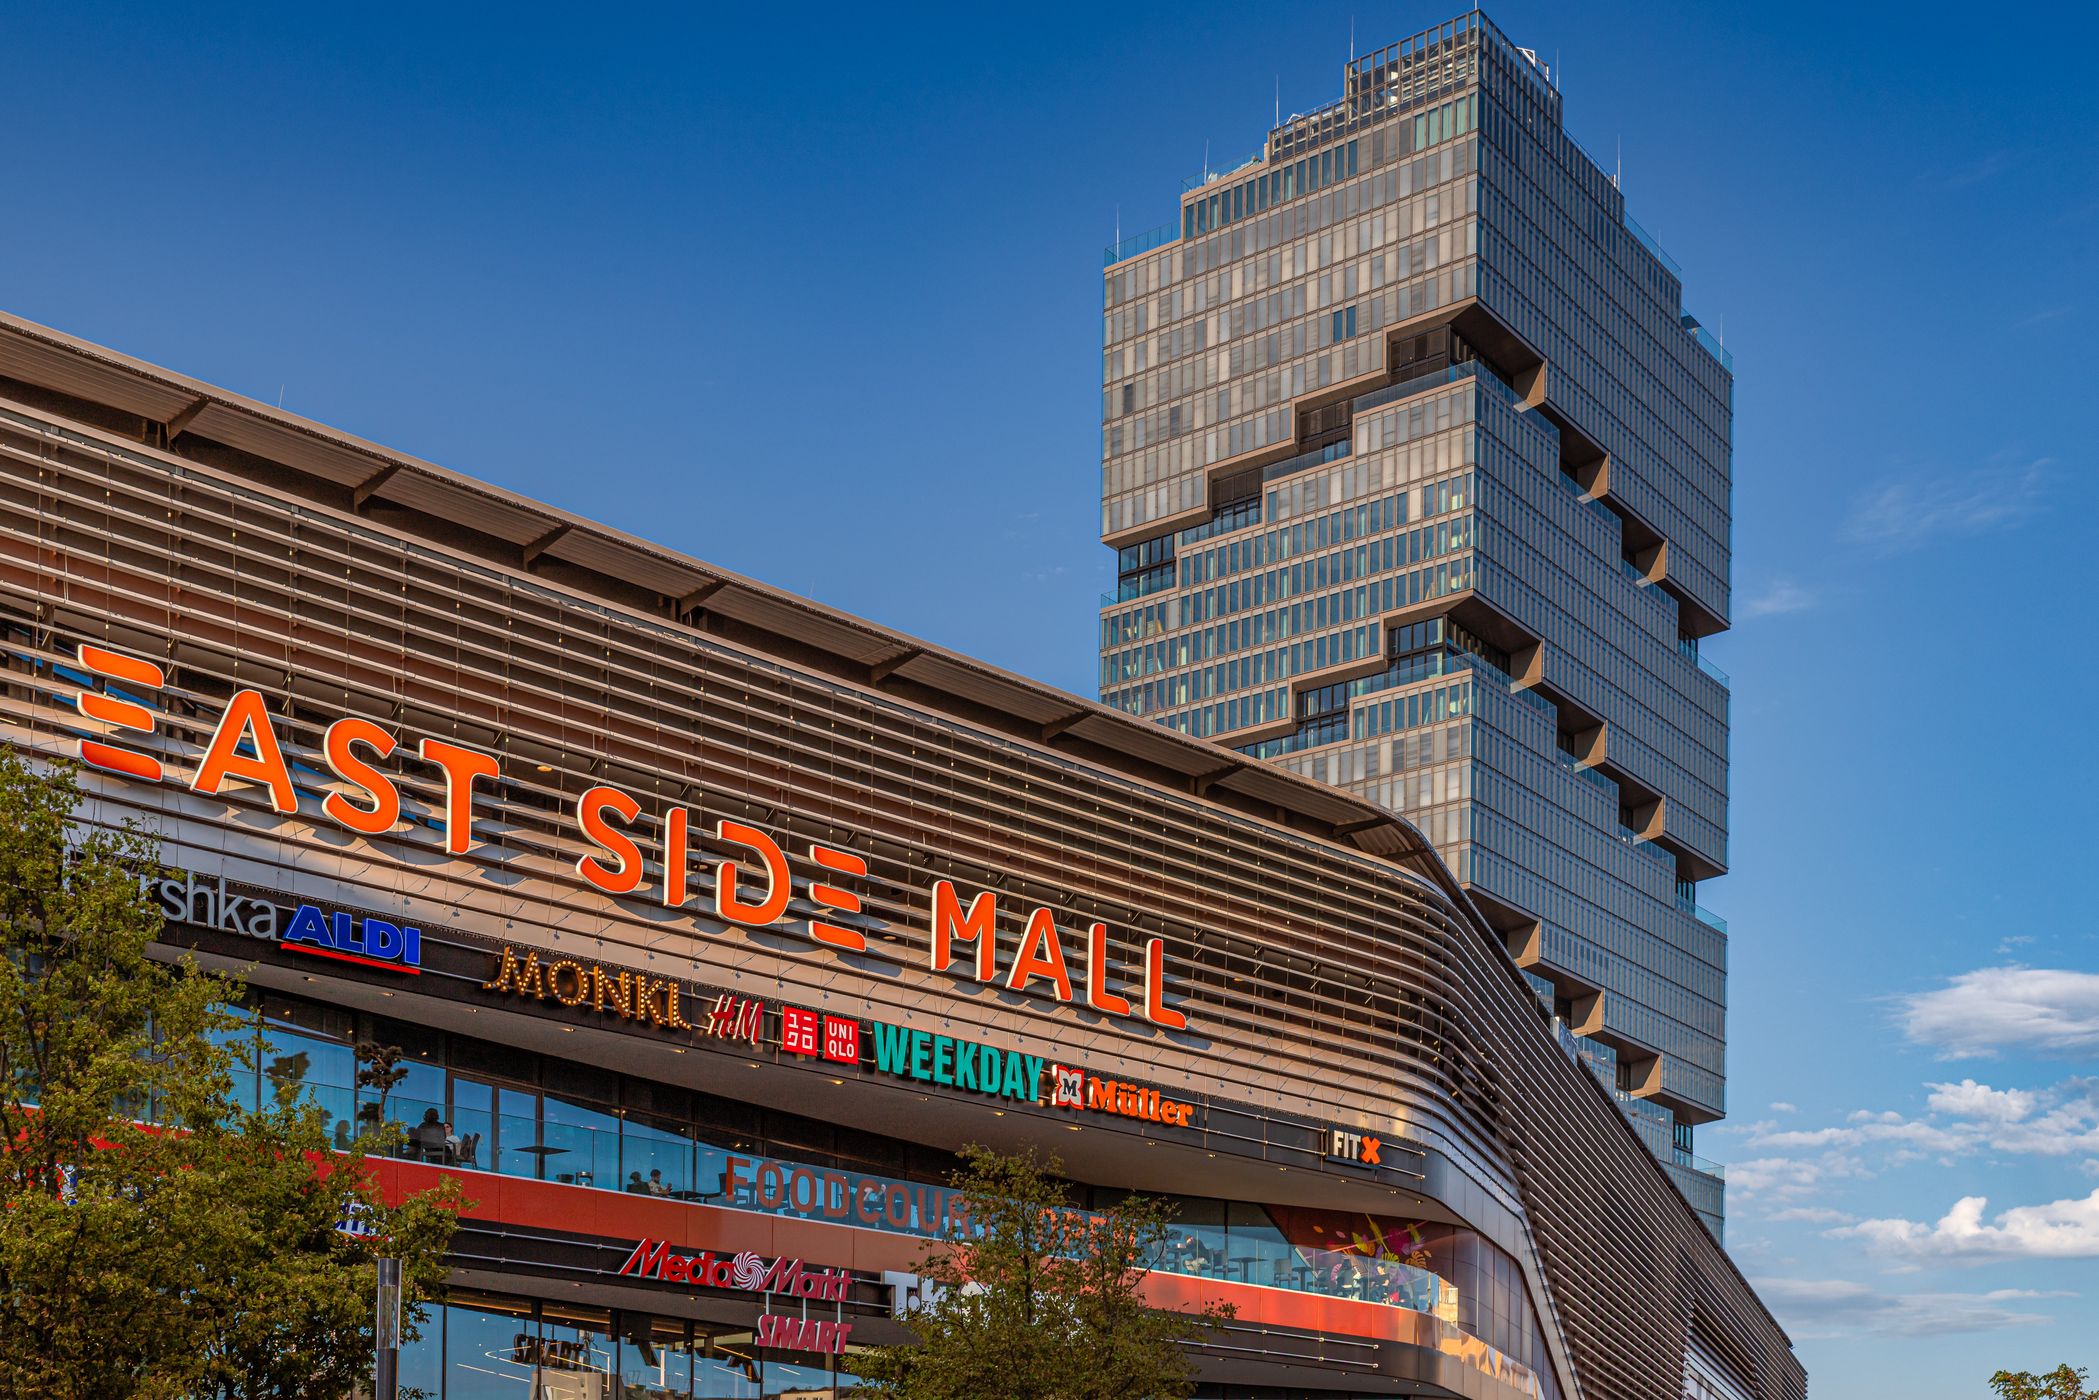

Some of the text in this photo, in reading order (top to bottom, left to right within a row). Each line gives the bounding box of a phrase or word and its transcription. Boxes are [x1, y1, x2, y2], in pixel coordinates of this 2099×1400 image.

[77, 643, 1187, 1030] EAST SIDE MALL
[283, 904, 421, 966] ALDI
[483, 946, 692, 1030] MONKI
[707, 994, 764, 1046] H&M
[828, 1023, 854, 1040] UNI
[827, 1041, 855, 1058] QLO
[873, 1021, 1044, 1102] WEEKDAY
[1087, 1077, 1194, 1127] Müller
[754, 1314, 853, 1355] SMART
